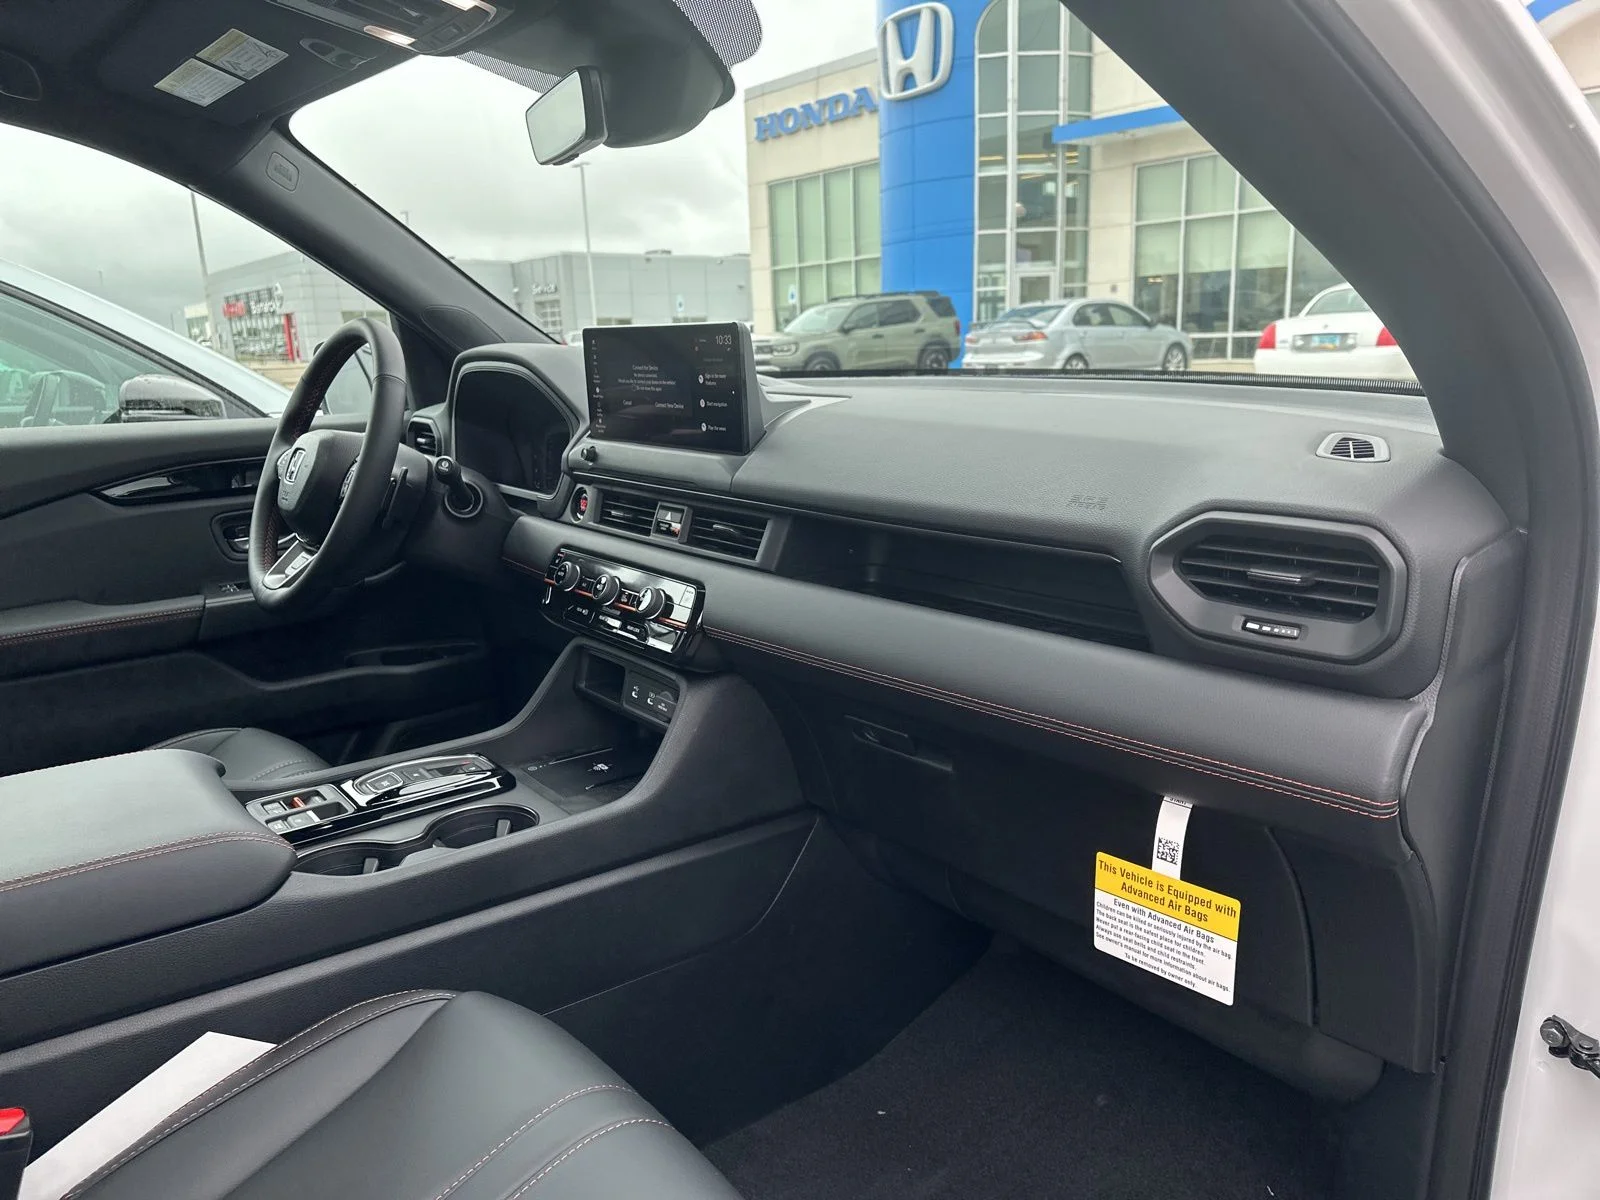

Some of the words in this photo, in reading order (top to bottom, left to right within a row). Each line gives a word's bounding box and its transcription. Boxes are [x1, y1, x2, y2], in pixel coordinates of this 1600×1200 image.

[754, 85, 879, 142] HONDA
[715, 335, 732, 345] 10:33
[1099, 860, 1117, 875] This
[1120, 867, 1153, 888] Vehicle
[1156, 880, 1165, 892] is
[1167, 884, 1212, 909] Equipped
[1215, 903, 1237, 918] with
[1121, 882, 1165, 906] Advanced
[1167, 899, 1182, 912] Air
[1184, 905, 1209, 922] Bags
[1096, 901, 1116, 913] Children
[1133, 915, 1147, 926] killed
[1153, 924, 1176, 938] seriously
[1176, 933, 1195, 945] injured
[1195, 940, 1202, 948] by
[1203, 943, 1212, 951] the
[1096, 908, 1105, 917] The
[1105, 912, 1117, 921] back
[1118, 918, 1129, 927] seat
[1134, 924, 1143, 932] the
[1143, 928, 1159, 938] safest
[1159, 934, 1173, 944] place
[1096, 917, 1110, 926] Never
[1110, 923, 1119, 931] put
[1123, 928, 1150, 944] rear-facing
[1150, 938, 1163, 948] child
[1163, 944, 1175, 953] seat
[1182, 951, 1191, 959] the
[1096, 924, 1113, 935] Always
[1113, 932, 1122, 940] use
[1122, 935, 1134, 943] seat
[1134, 939, 1146, 949] belts
[1147, 945, 1157, 953] and
[1157, 950, 1170, 959] child
[1113, 898, 1130, 910] Even
[1131, 906, 1146, 917] with
[1148, 911, 1182, 931] Advanced
[1183, 925, 1194, 935] Air
[1196, 930, 1215, 943] Bags
[1096, 931, 1105, 940] See
[1123, 943, 1142, 955] manual
[1149, 954, 1163, 964] more
[1163, 959, 1192, 976] information
[1192, 972, 1207, 982] about
[1125, 952, 1131, 960] To
[1138, 958, 1160, 972] removed
[1167, 971, 1184, 982] owner
